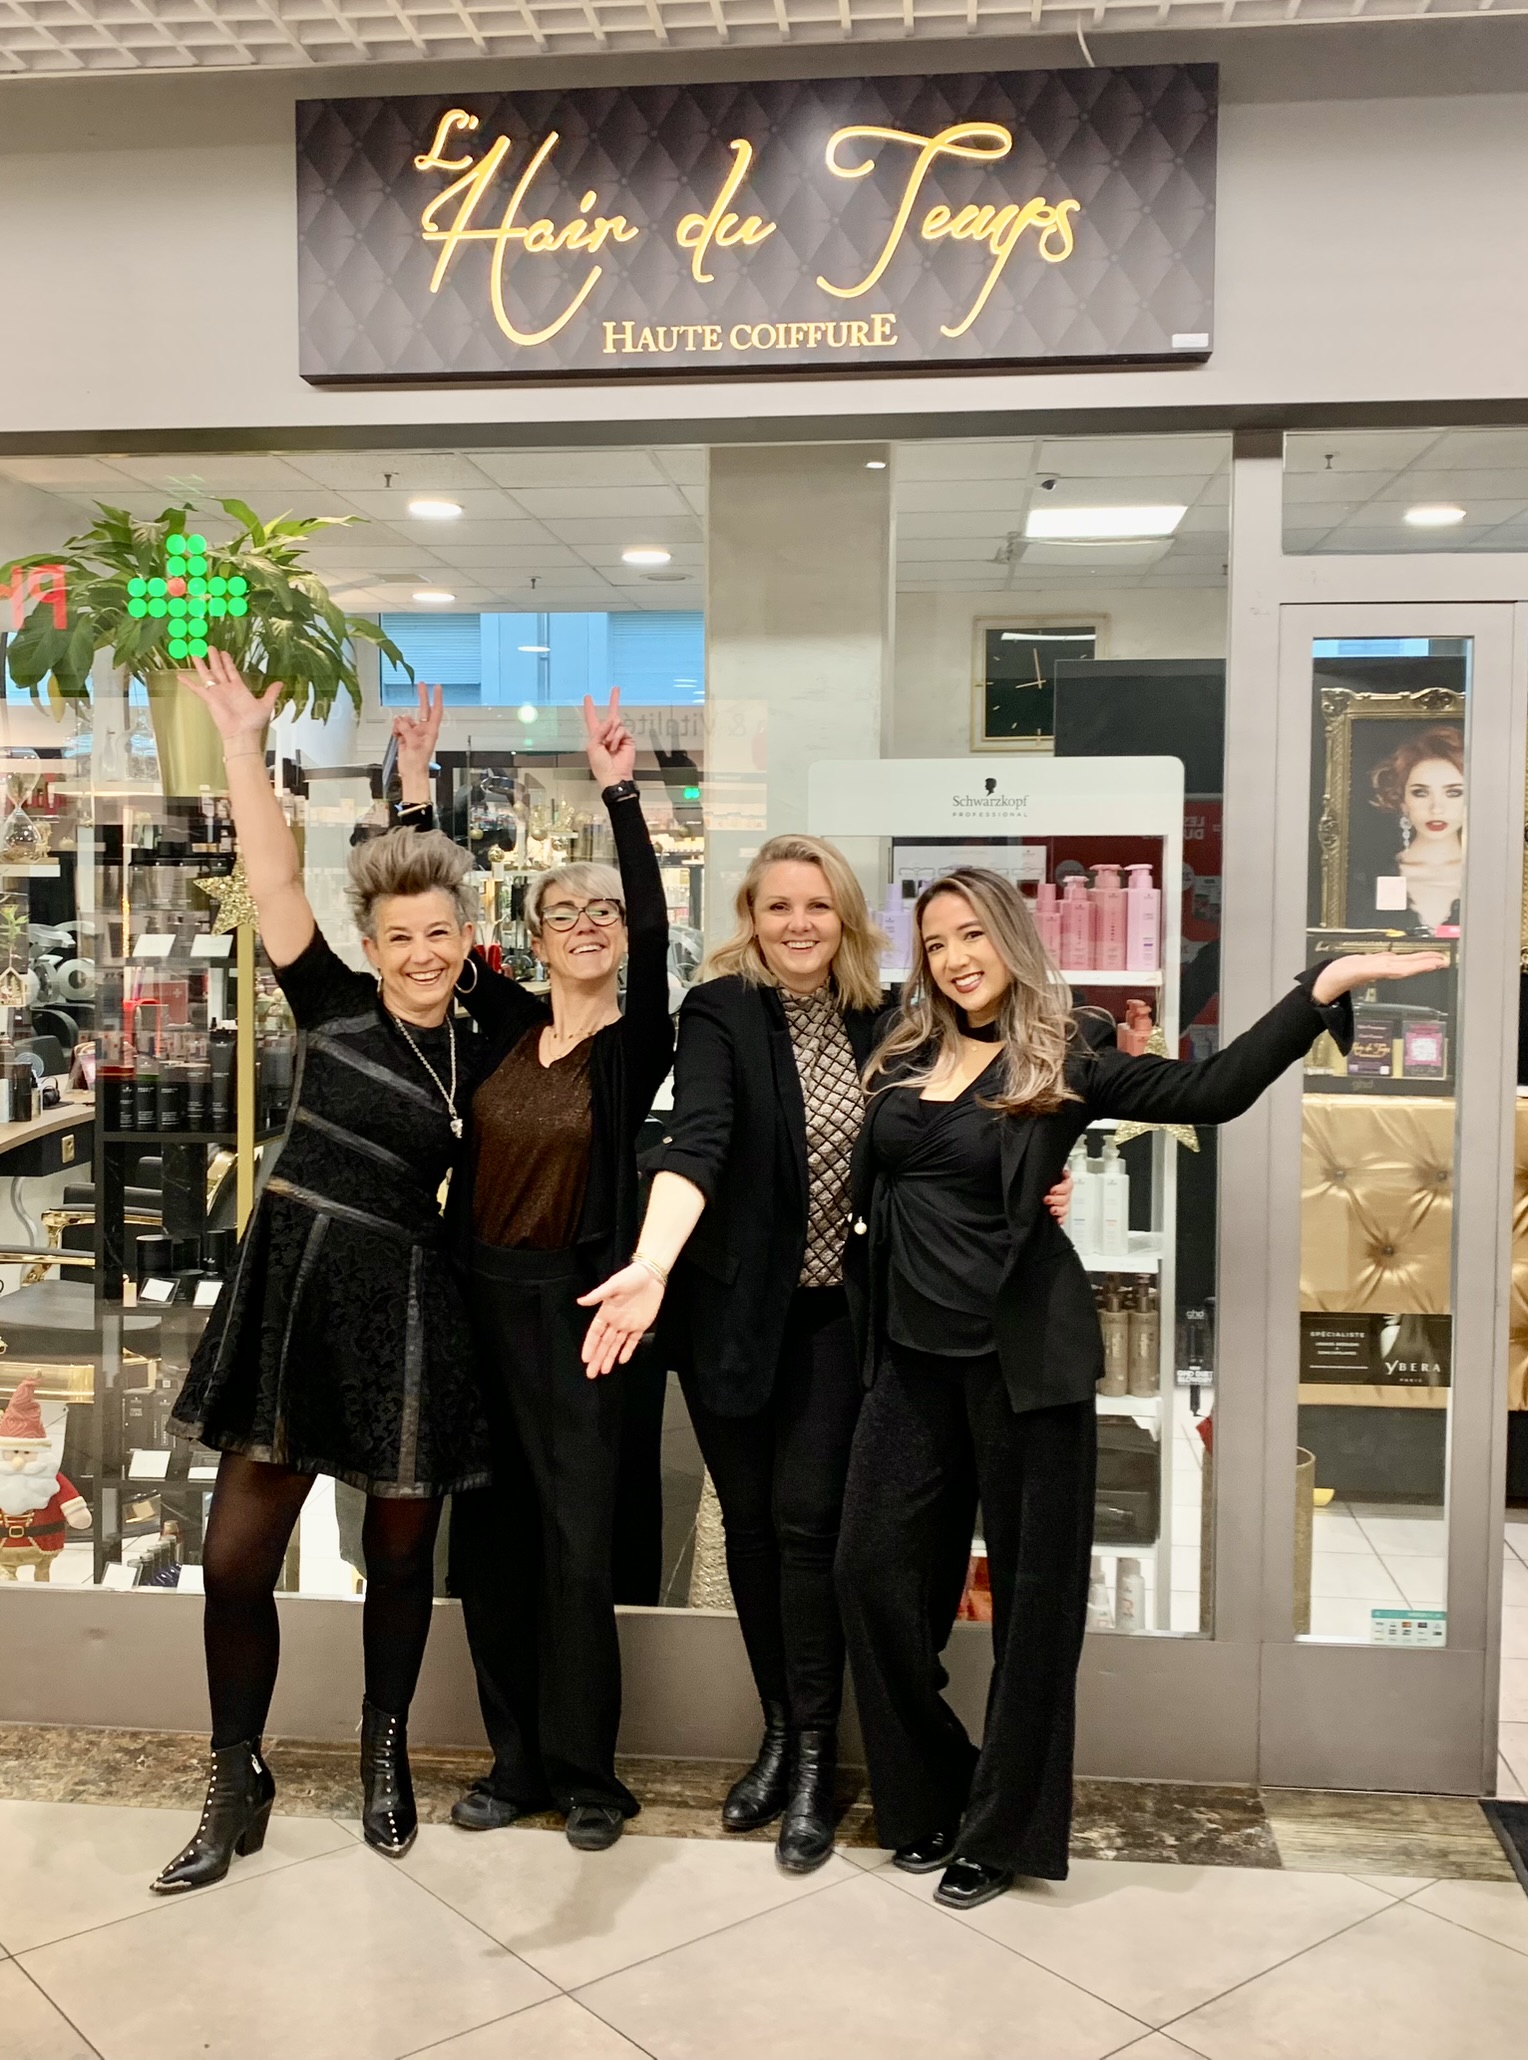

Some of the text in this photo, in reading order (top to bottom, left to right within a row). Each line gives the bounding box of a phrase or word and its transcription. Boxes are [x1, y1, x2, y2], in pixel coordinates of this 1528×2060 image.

[676, 139, 777, 283] du
[816, 122, 1081, 338] Temps
[952, 794, 1030, 810] Schwarzkopf
[1309, 1330, 1365, 1338] SPÉCIALISTE
